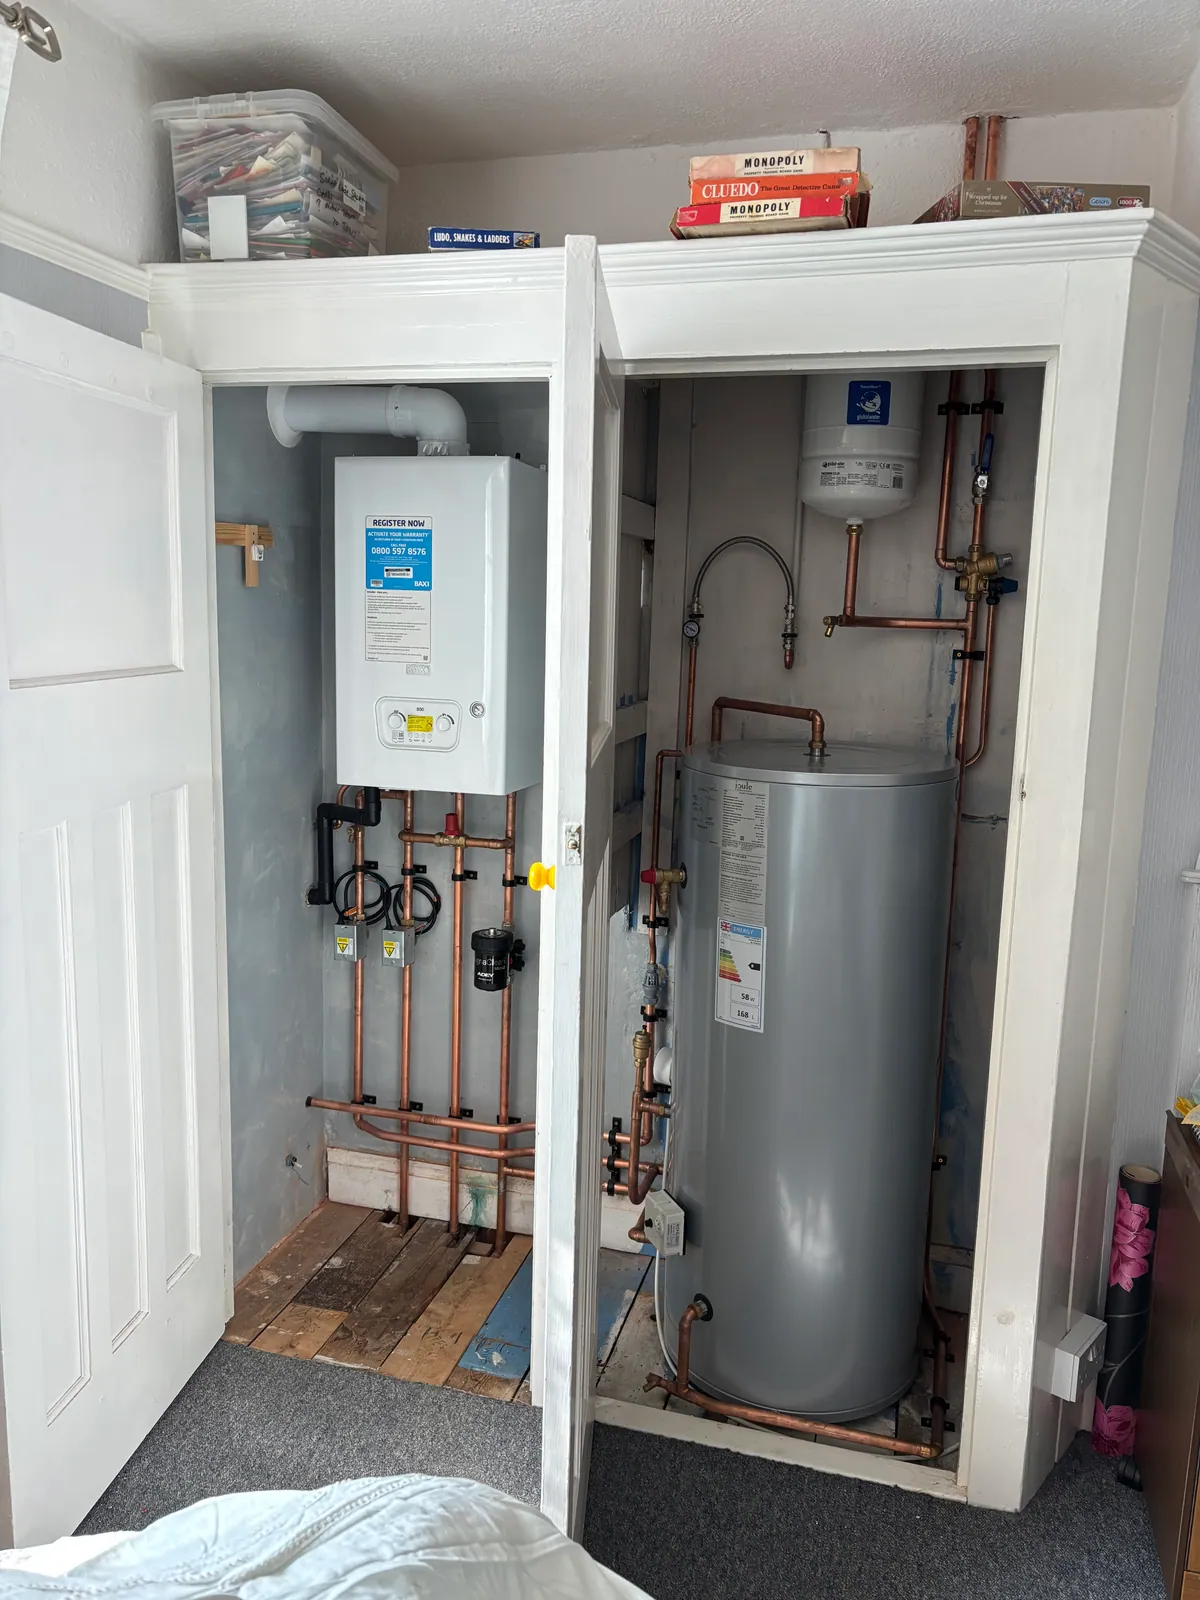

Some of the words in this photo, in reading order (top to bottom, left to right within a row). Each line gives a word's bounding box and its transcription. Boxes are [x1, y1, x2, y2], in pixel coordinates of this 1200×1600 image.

[744, 155, 805, 169] MONOPOLY
[702, 182, 758, 199] CLUEDO
[968, 193, 992, 201] Wrapped
[434, 232, 452, 243] LUDO,
[453, 233, 476, 242] SNAKES
[477, 234, 482, 242] &
[484, 234, 510, 244] LADDERS
[373, 519, 406, 527] REGISTER
[371, 547, 390, 555] 0800
[407, 548, 427, 556] 8576
[735, 781, 753, 791] joule
[733, 925, 754, 935] ENERGY
[737, 1010, 749, 1018] 168
